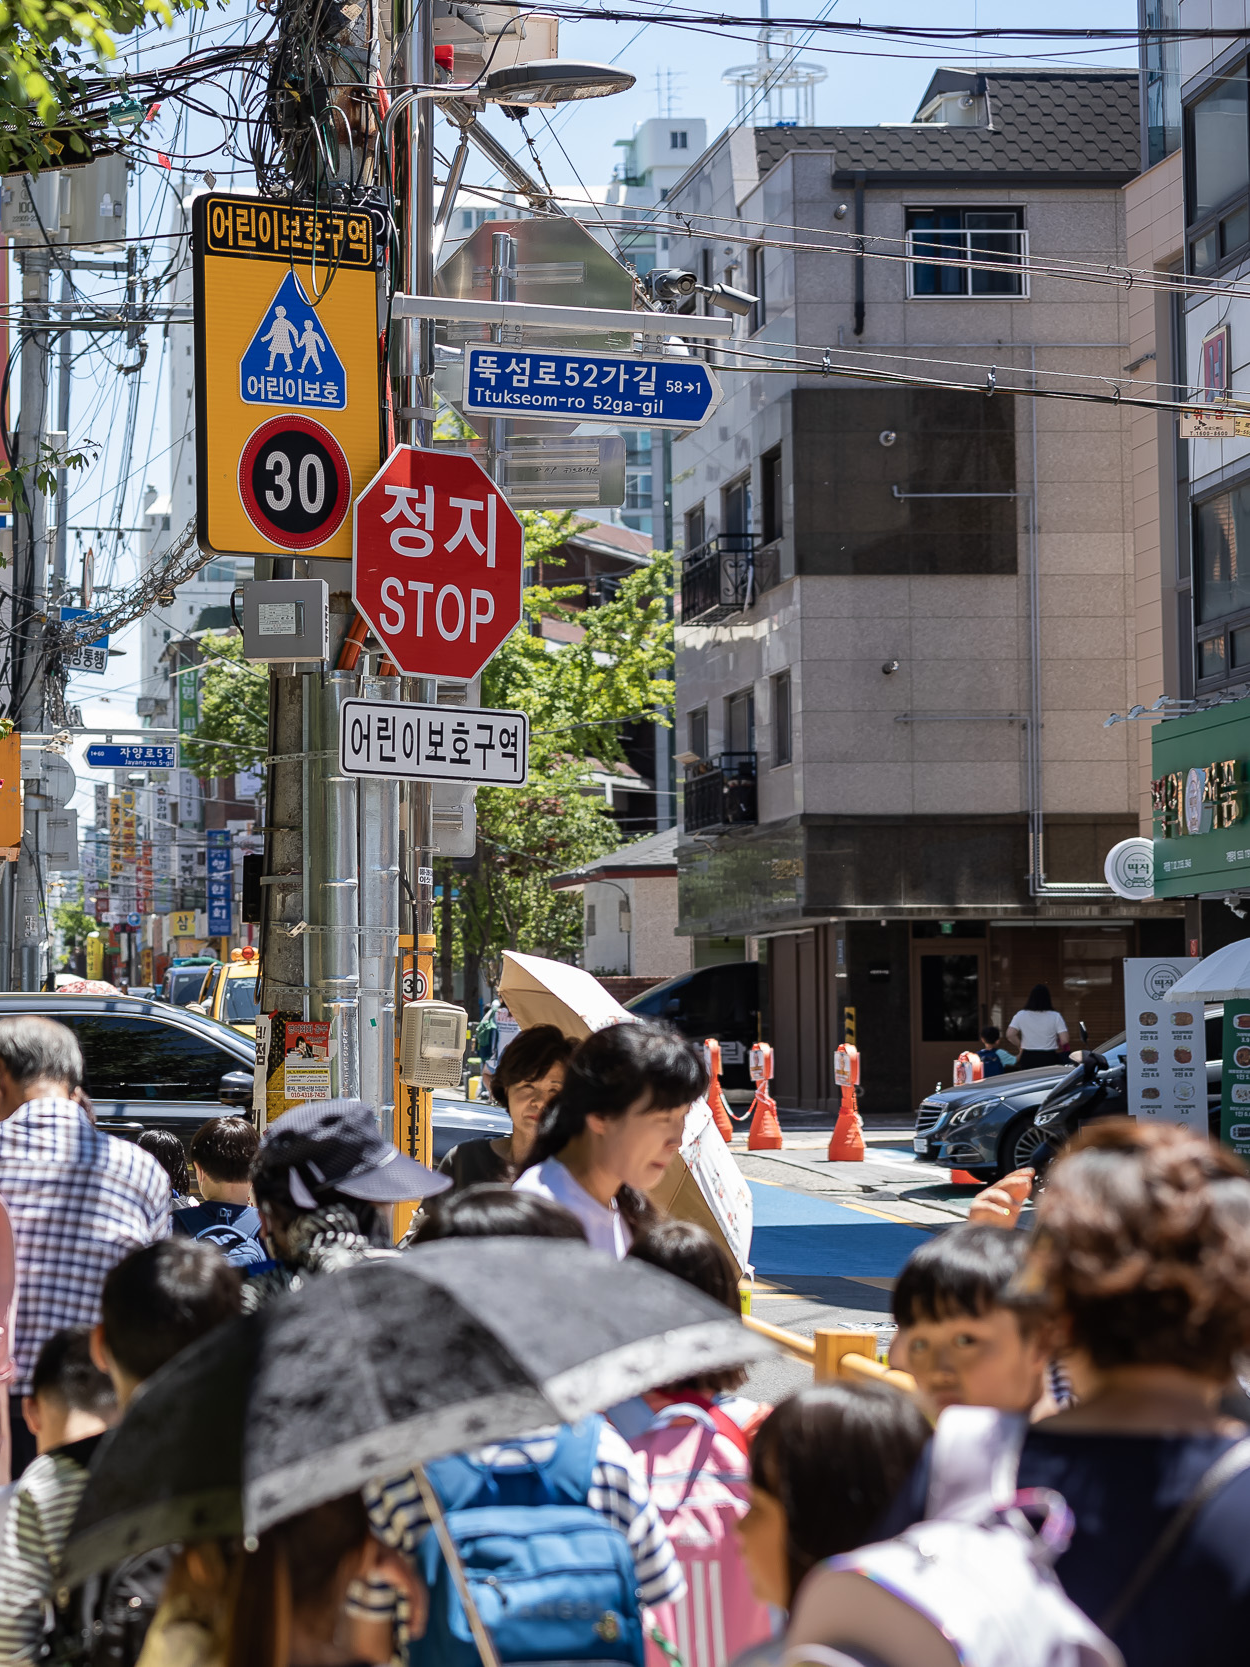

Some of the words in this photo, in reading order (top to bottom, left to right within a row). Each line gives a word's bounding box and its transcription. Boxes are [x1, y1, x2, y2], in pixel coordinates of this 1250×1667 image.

[212, 205, 368, 260] 어린이보호구역
[247, 375, 341, 404] 어린이보호
[474, 355, 657, 396] 뚝섬로52가길
[474, 387, 586, 409] Ttukseom-ro
[592, 395, 664, 416] 52ga-gil
[265, 451, 326, 514] 30
[380, 485, 496, 568] 정지
[379, 576, 495, 643] STOP
[158, 759, 174, 767] 5-gil
[351, 713, 518, 773] 어린이보호구역
[403, 978, 424, 994] 30
